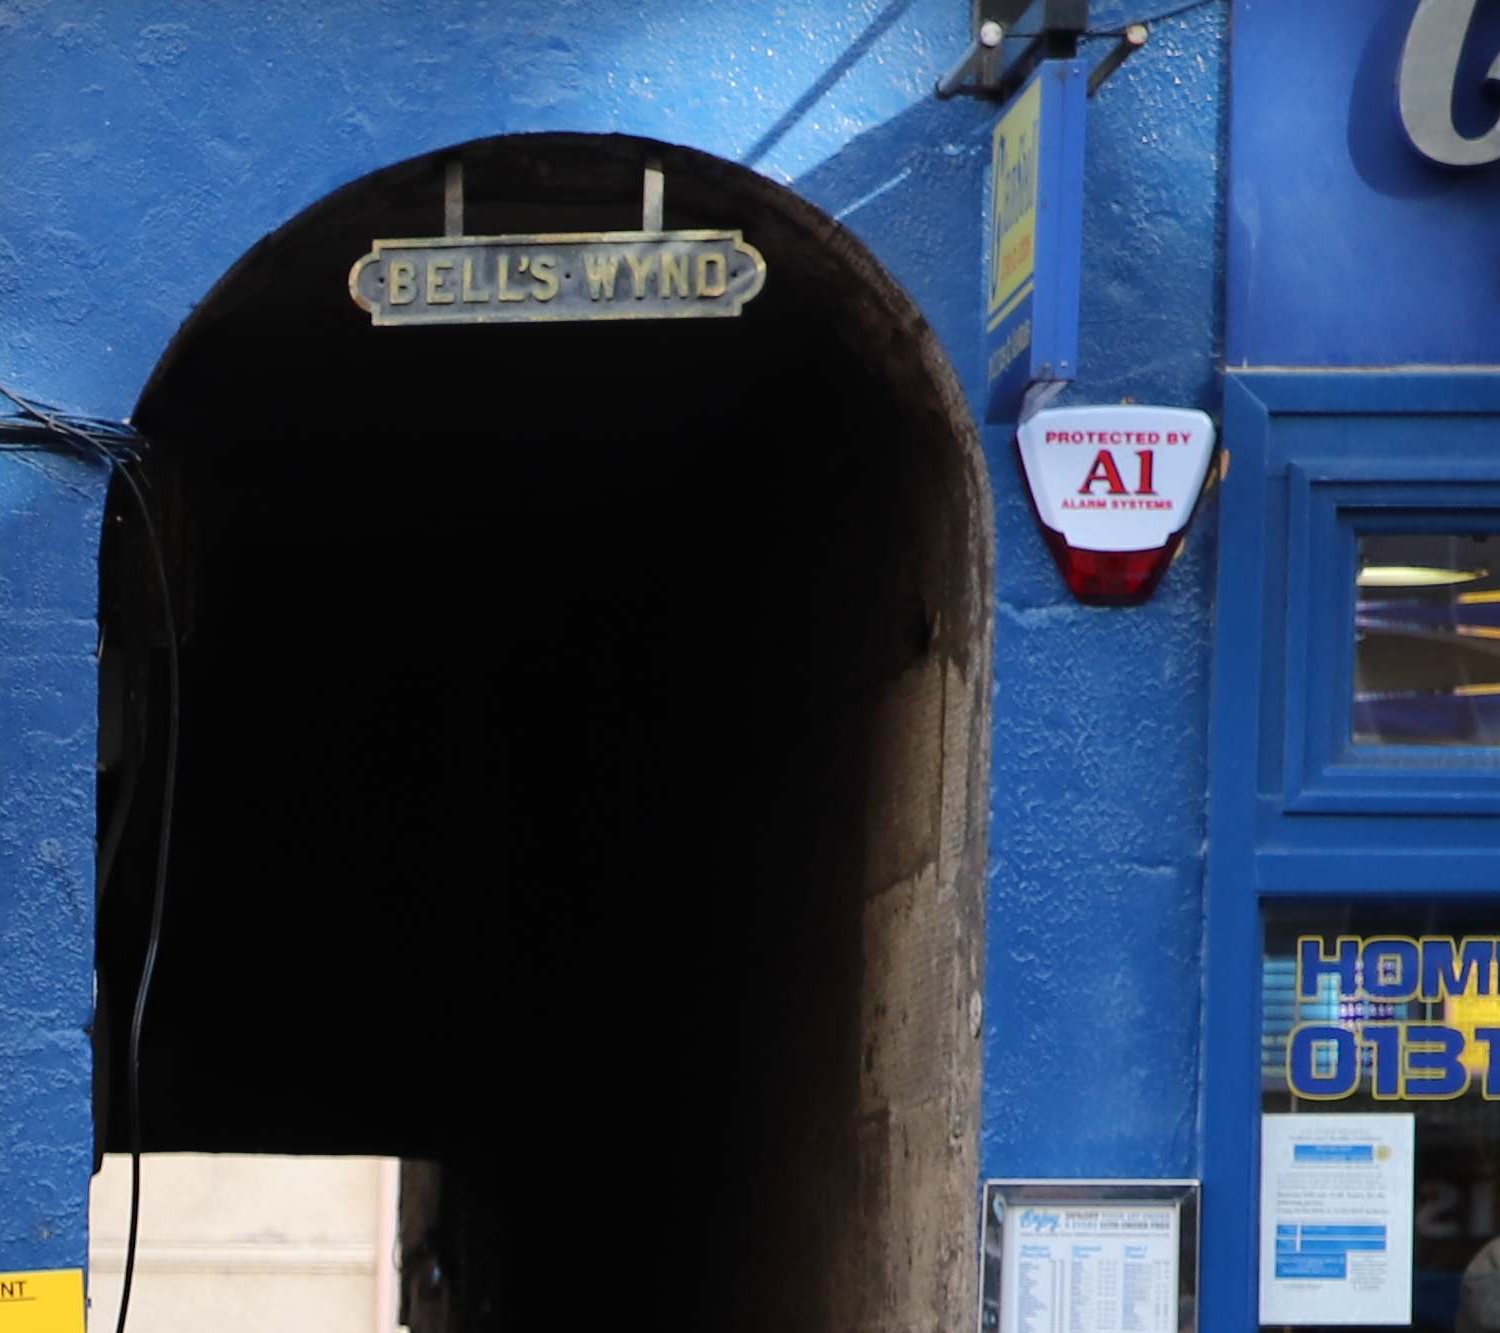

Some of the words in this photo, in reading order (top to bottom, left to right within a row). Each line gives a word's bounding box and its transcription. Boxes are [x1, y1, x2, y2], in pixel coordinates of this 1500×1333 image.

[387, 253, 560, 306] BELL'S
[582, 252, 727, 300] WYND
[1046, 432, 1160, 444] PROTECTED
[1167, 433, 1190, 444] BY
[1111, 500, 1172, 510] SYSTEMS
[1297, 935, 1500, 1002] HOM
